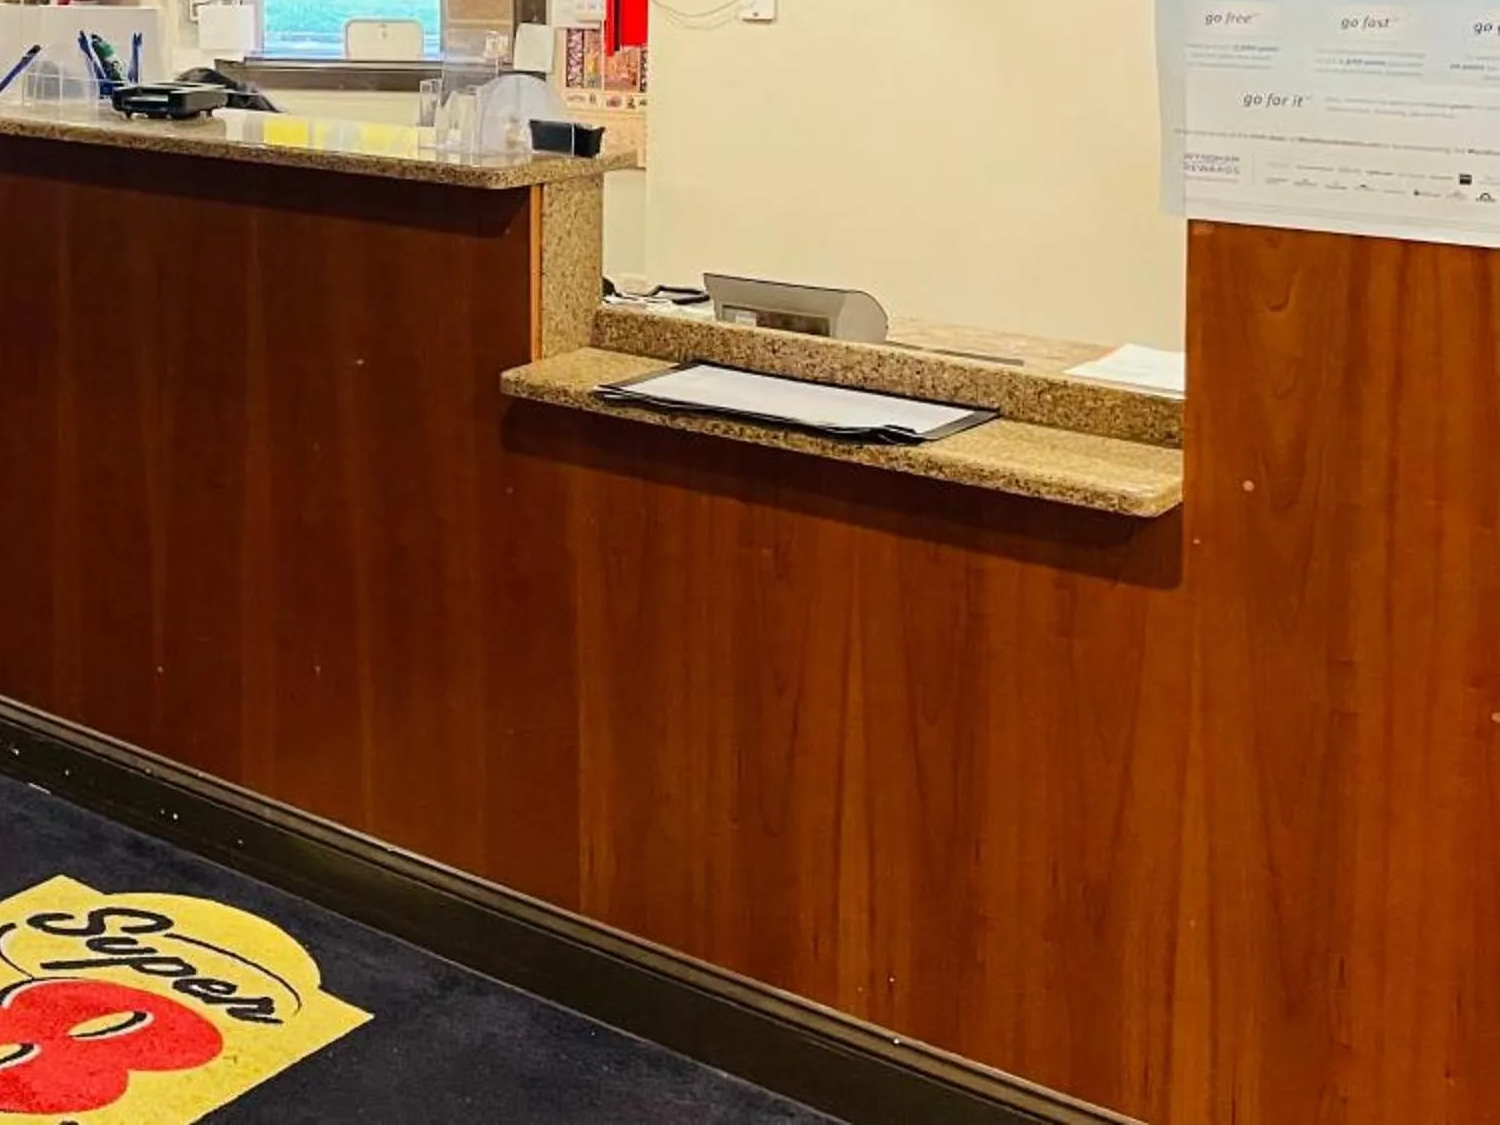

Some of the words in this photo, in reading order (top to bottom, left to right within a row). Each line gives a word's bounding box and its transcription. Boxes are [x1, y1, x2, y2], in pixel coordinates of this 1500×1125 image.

[1205, 14, 1222, 26] go
[1225, 12, 1252, 25] free
[1341, 18, 1359, 29] go
[1362, 16, 1389, 30] fast
[1474, 22, 1493, 35] go
[1243, 94, 1263, 107] go
[1266, 93, 1288, 108] for
[1291, 94, 1304, 107] it
[26, 907, 284, 1024] Super
